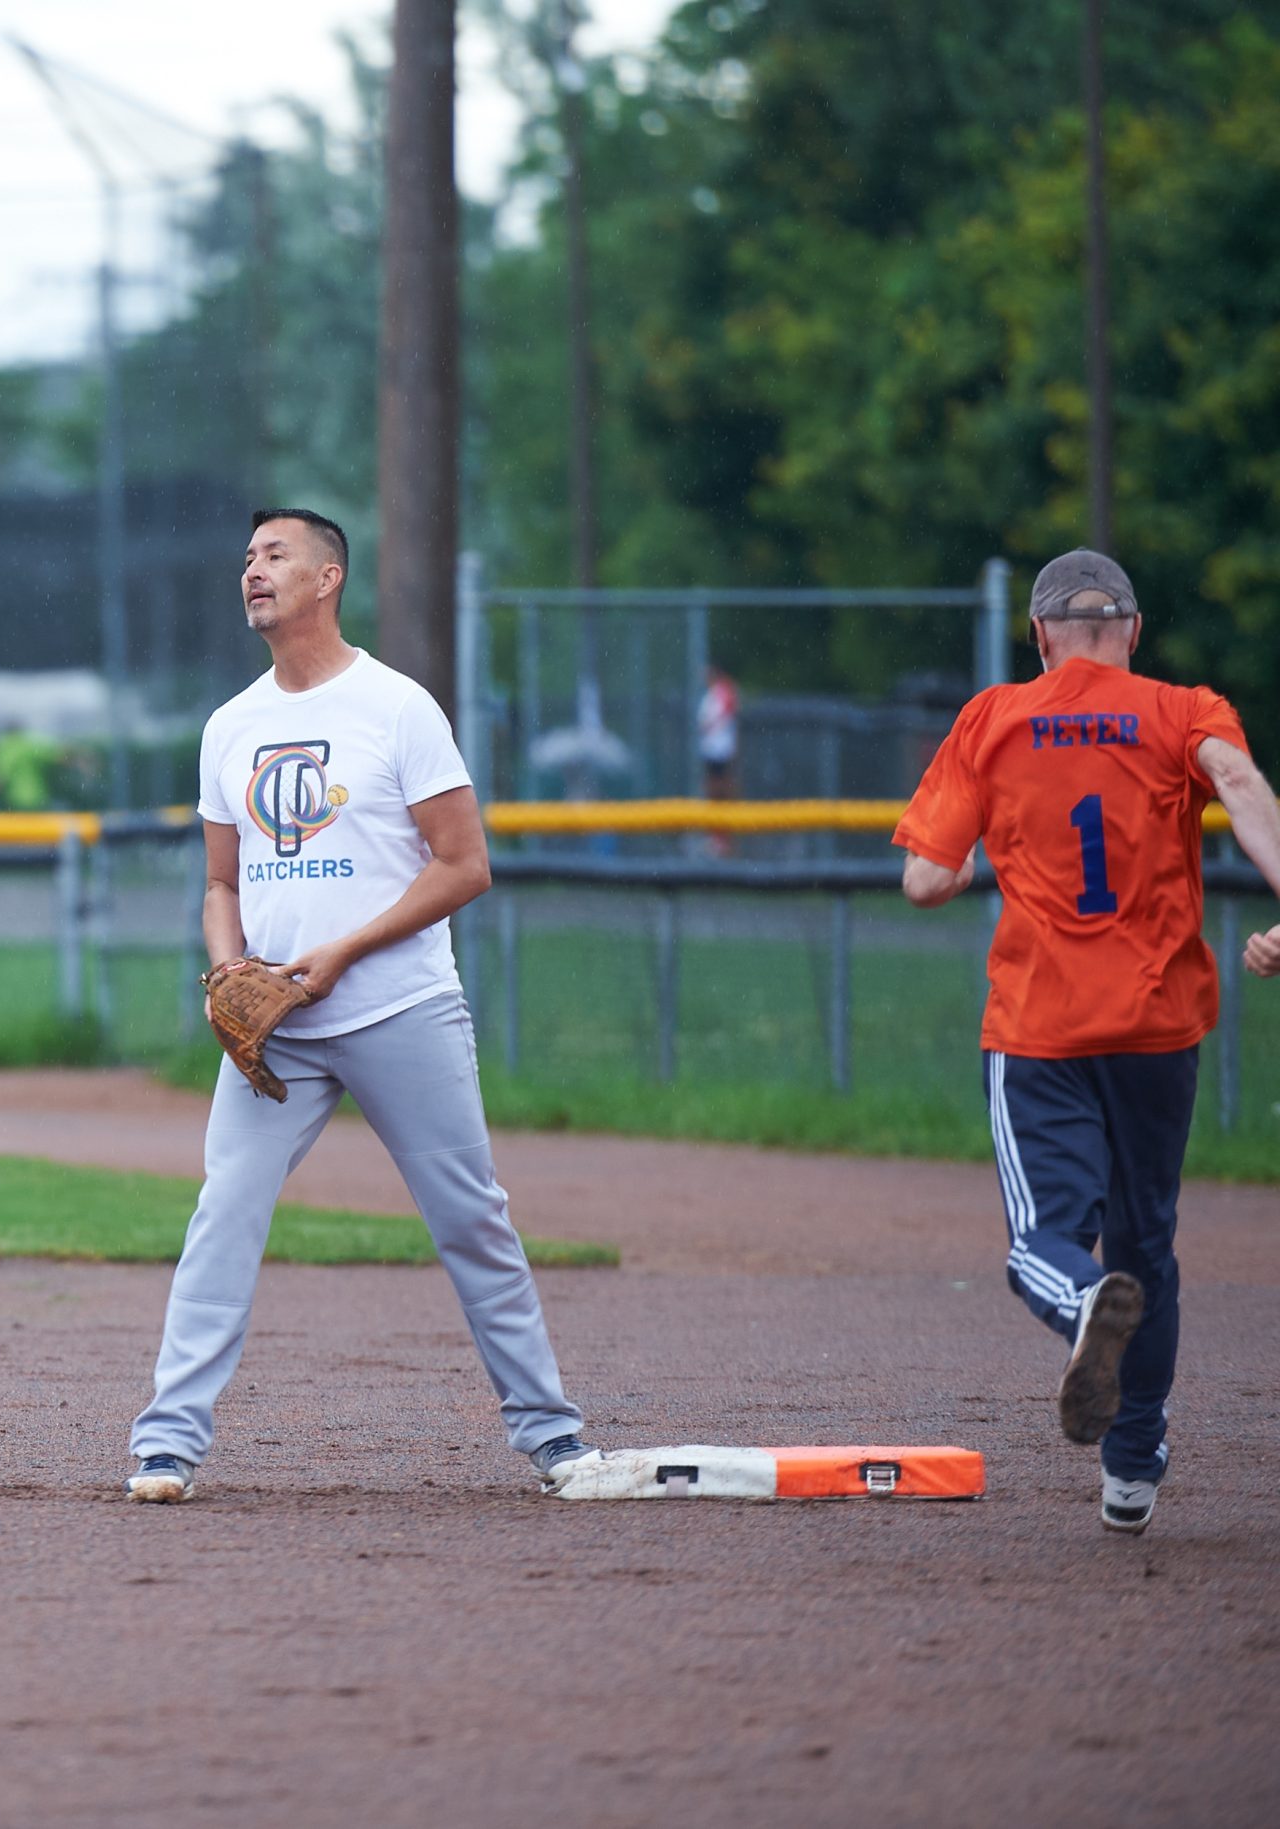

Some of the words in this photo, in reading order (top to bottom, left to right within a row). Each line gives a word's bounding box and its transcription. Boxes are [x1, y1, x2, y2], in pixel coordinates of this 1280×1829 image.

[1029, 713, 1140, 750] PETER
[247, 858, 354, 882] CATCHERS
[1070, 794, 1118, 915] 1
